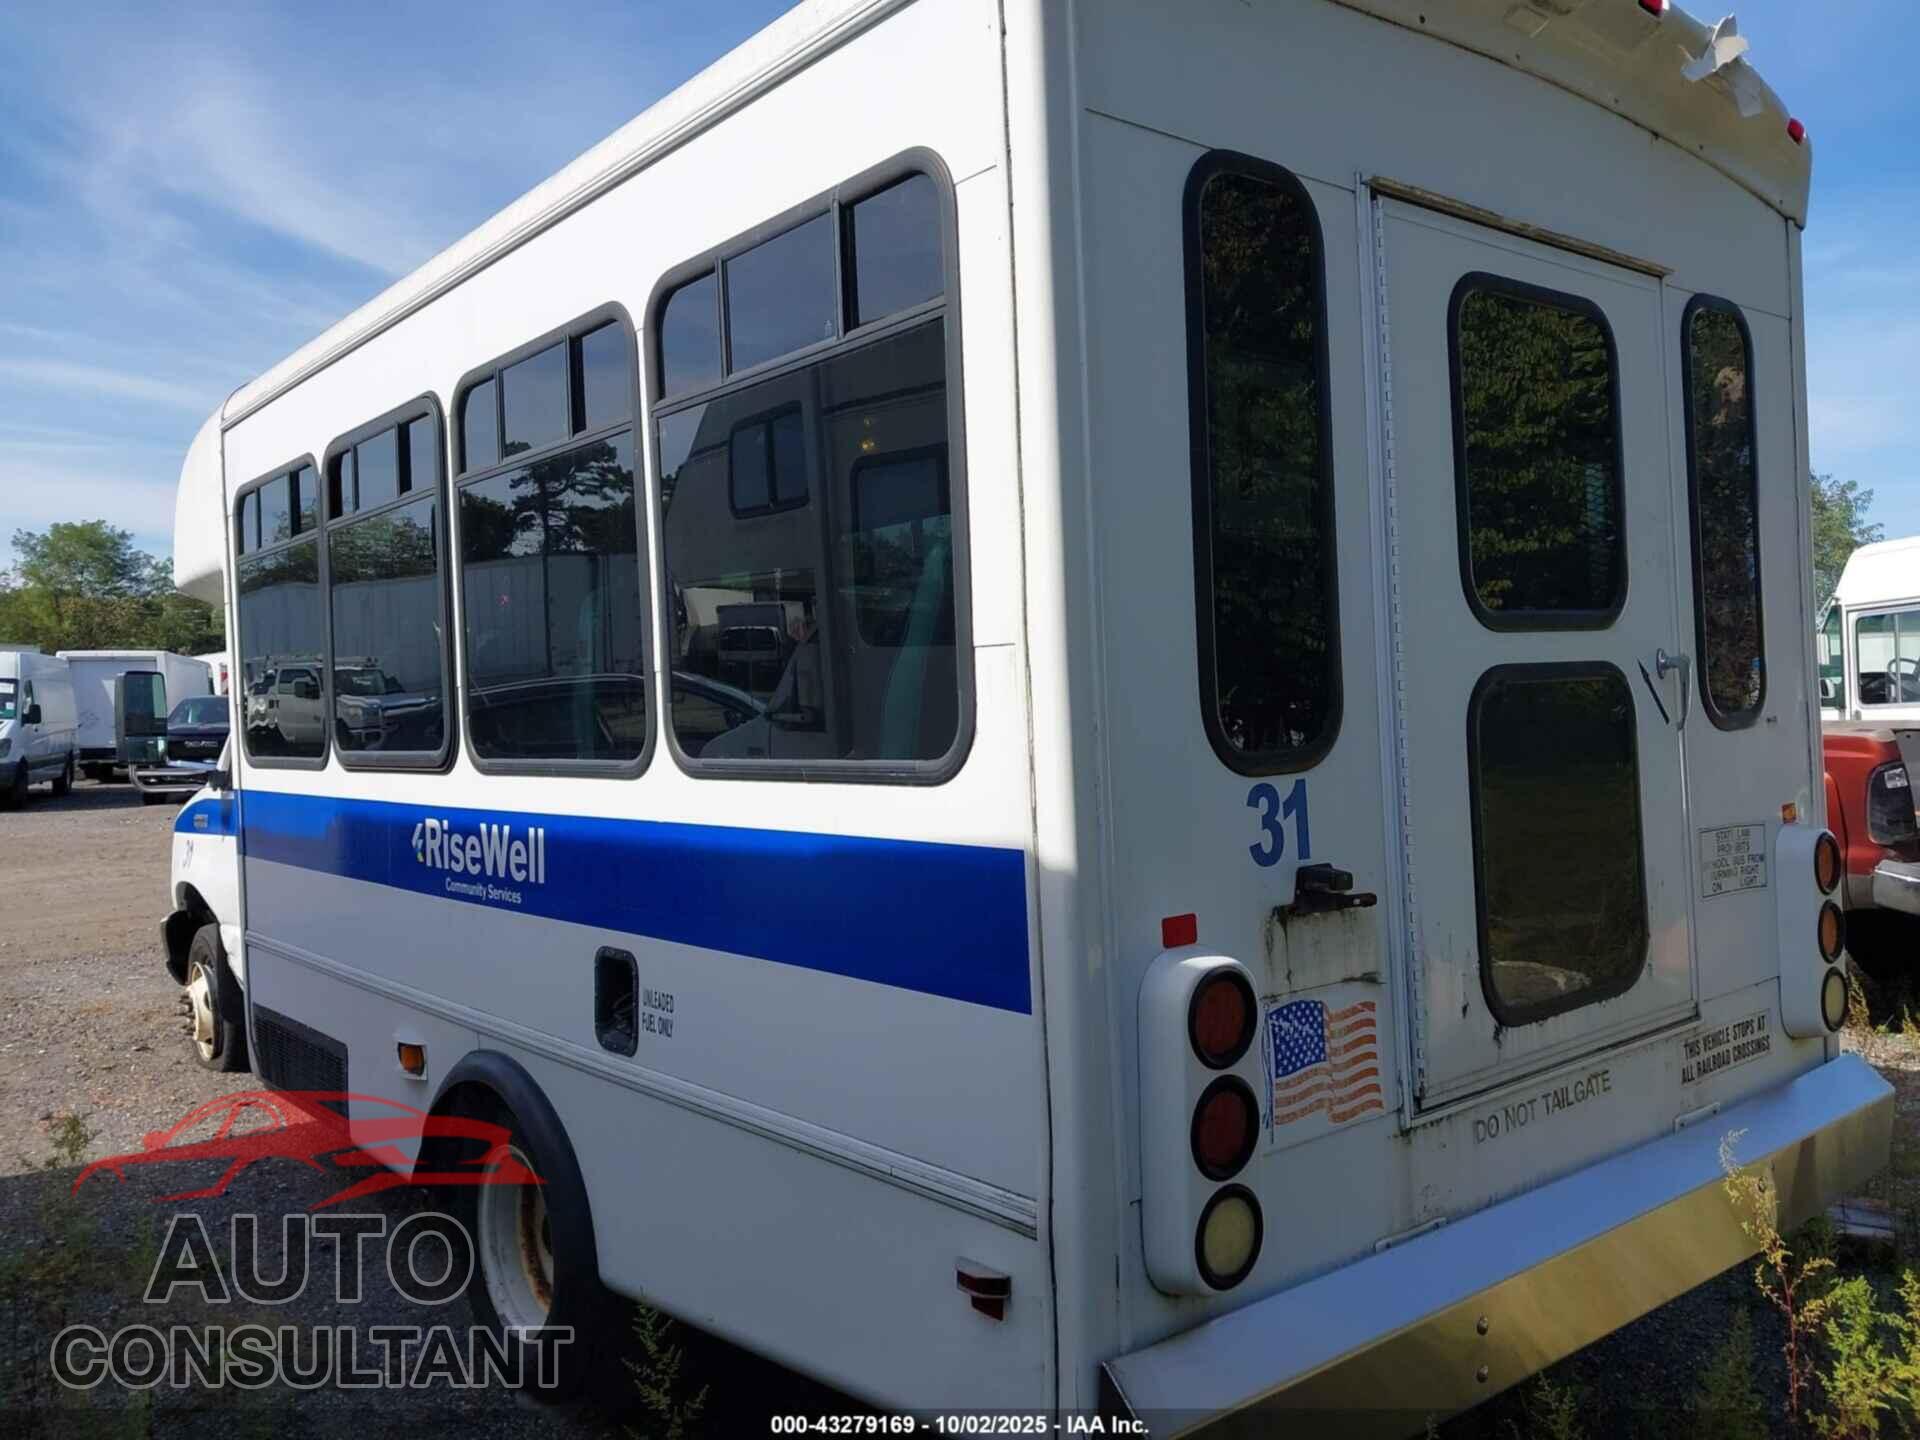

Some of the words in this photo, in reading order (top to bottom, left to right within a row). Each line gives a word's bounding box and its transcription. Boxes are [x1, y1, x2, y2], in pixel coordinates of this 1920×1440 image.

[1245, 778, 1312, 867] 31
[424, 817, 545, 884] RiseWell
[445, 877, 487, 901] Community
[487, 883, 522, 904] Services
[642, 988, 674, 1013] UNLEADED
[641, 1012, 656, 1034] FUEL
[657, 1015, 673, 1038] ONLY
[1684, 1038, 1701, 1060] THIS
[1702, 1026, 1730, 1053] VEHICLE
[1732, 1018, 1754, 1041] STOPS
[1757, 1014, 1767, 1032] AT
[1681, 1064, 1696, 1085] ALL
[1696, 1048, 1730, 1079] RAILROAD
[1732, 1034, 1770, 1062] CROSSINGS
[1472, 1113, 1500, 1145] DO
[1503, 1099, 1537, 1134] NOT
[1541, 1069, 1612, 1116] TAILGATE
